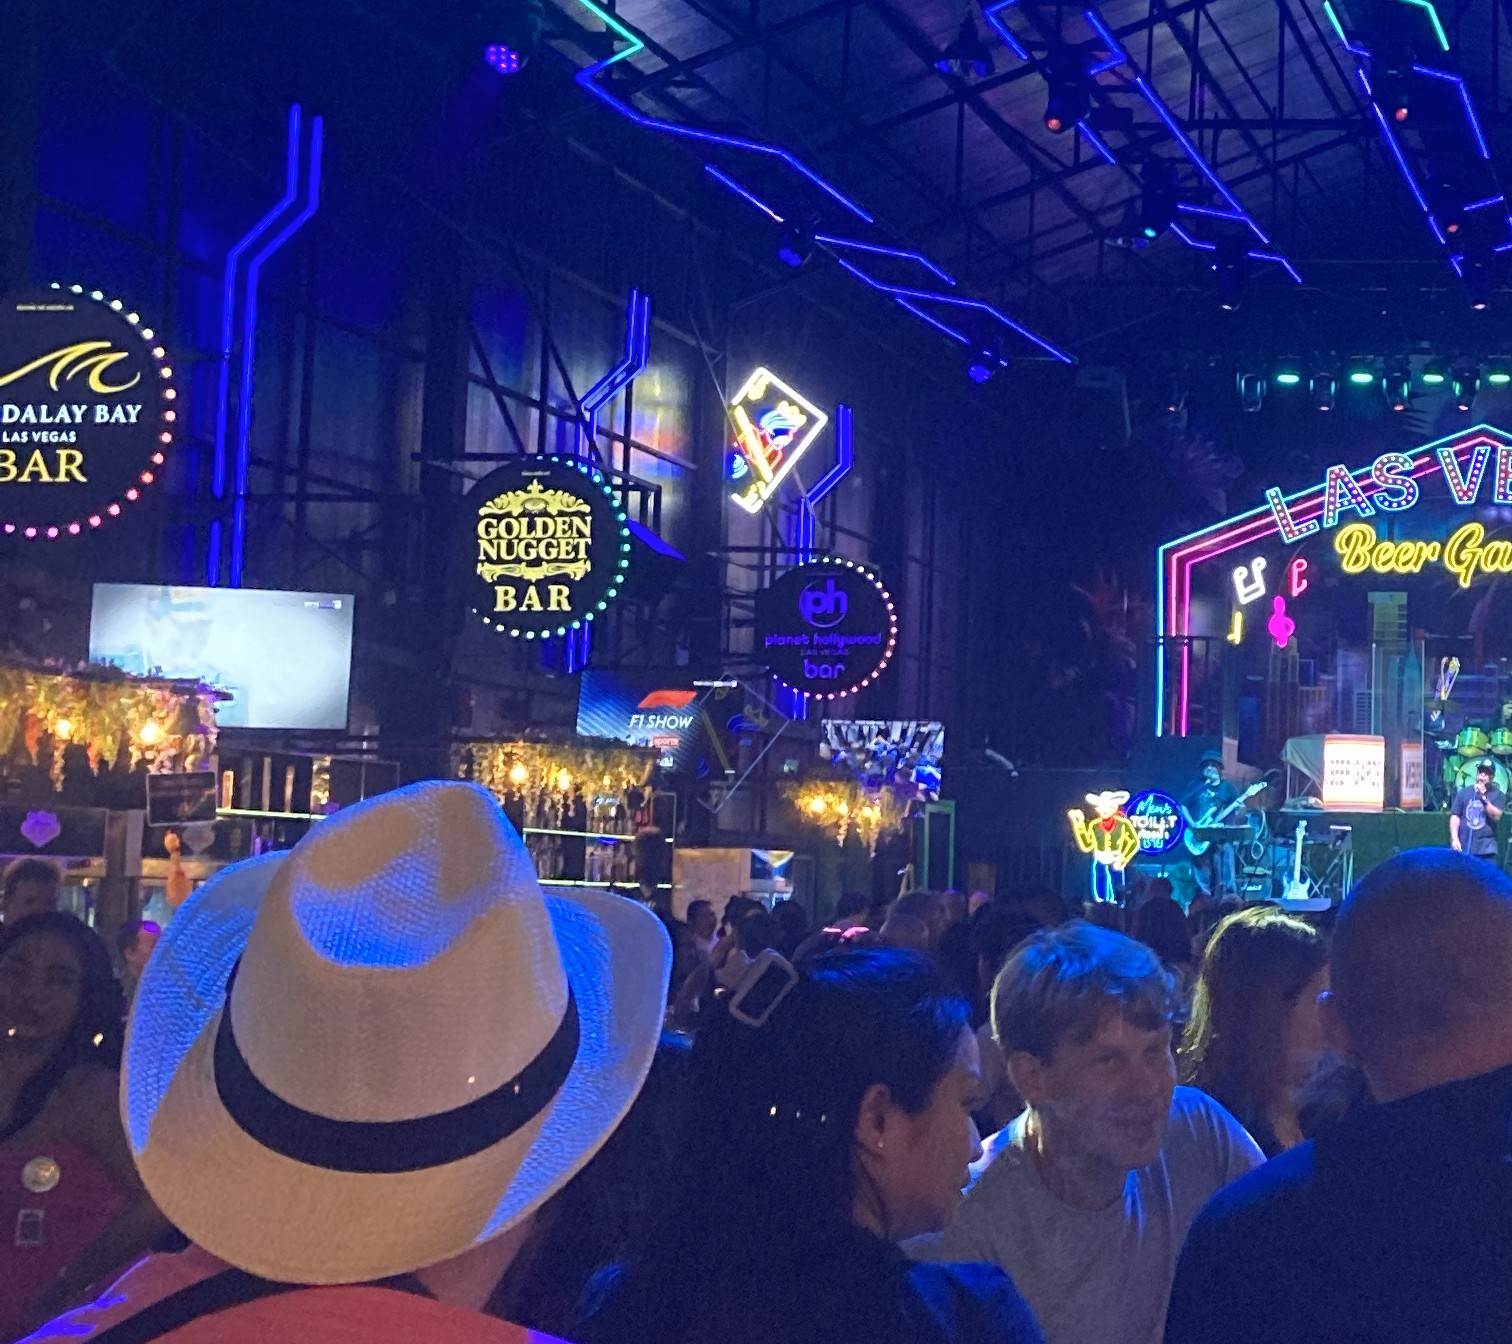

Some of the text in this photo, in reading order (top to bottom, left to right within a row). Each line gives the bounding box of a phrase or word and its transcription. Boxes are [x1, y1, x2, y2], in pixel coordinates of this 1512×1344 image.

[0, 403, 143, 424] DALAY BAY
[2, 430, 78, 444] LAS VEGAS
[0, 448, 88, 483] BAR
[1265, 451, 1420, 545] LAS
[476, 516, 593, 539] GOLDEN
[477, 537, 593, 561] NUGGET
[1333, 522, 1441, 575] Beer
[493, 584, 573, 612] BAR
[765, 632, 882, 649] planet hollywood
[804, 658, 846, 679] bar
[628, 714, 694, 730] F1 SHOW
